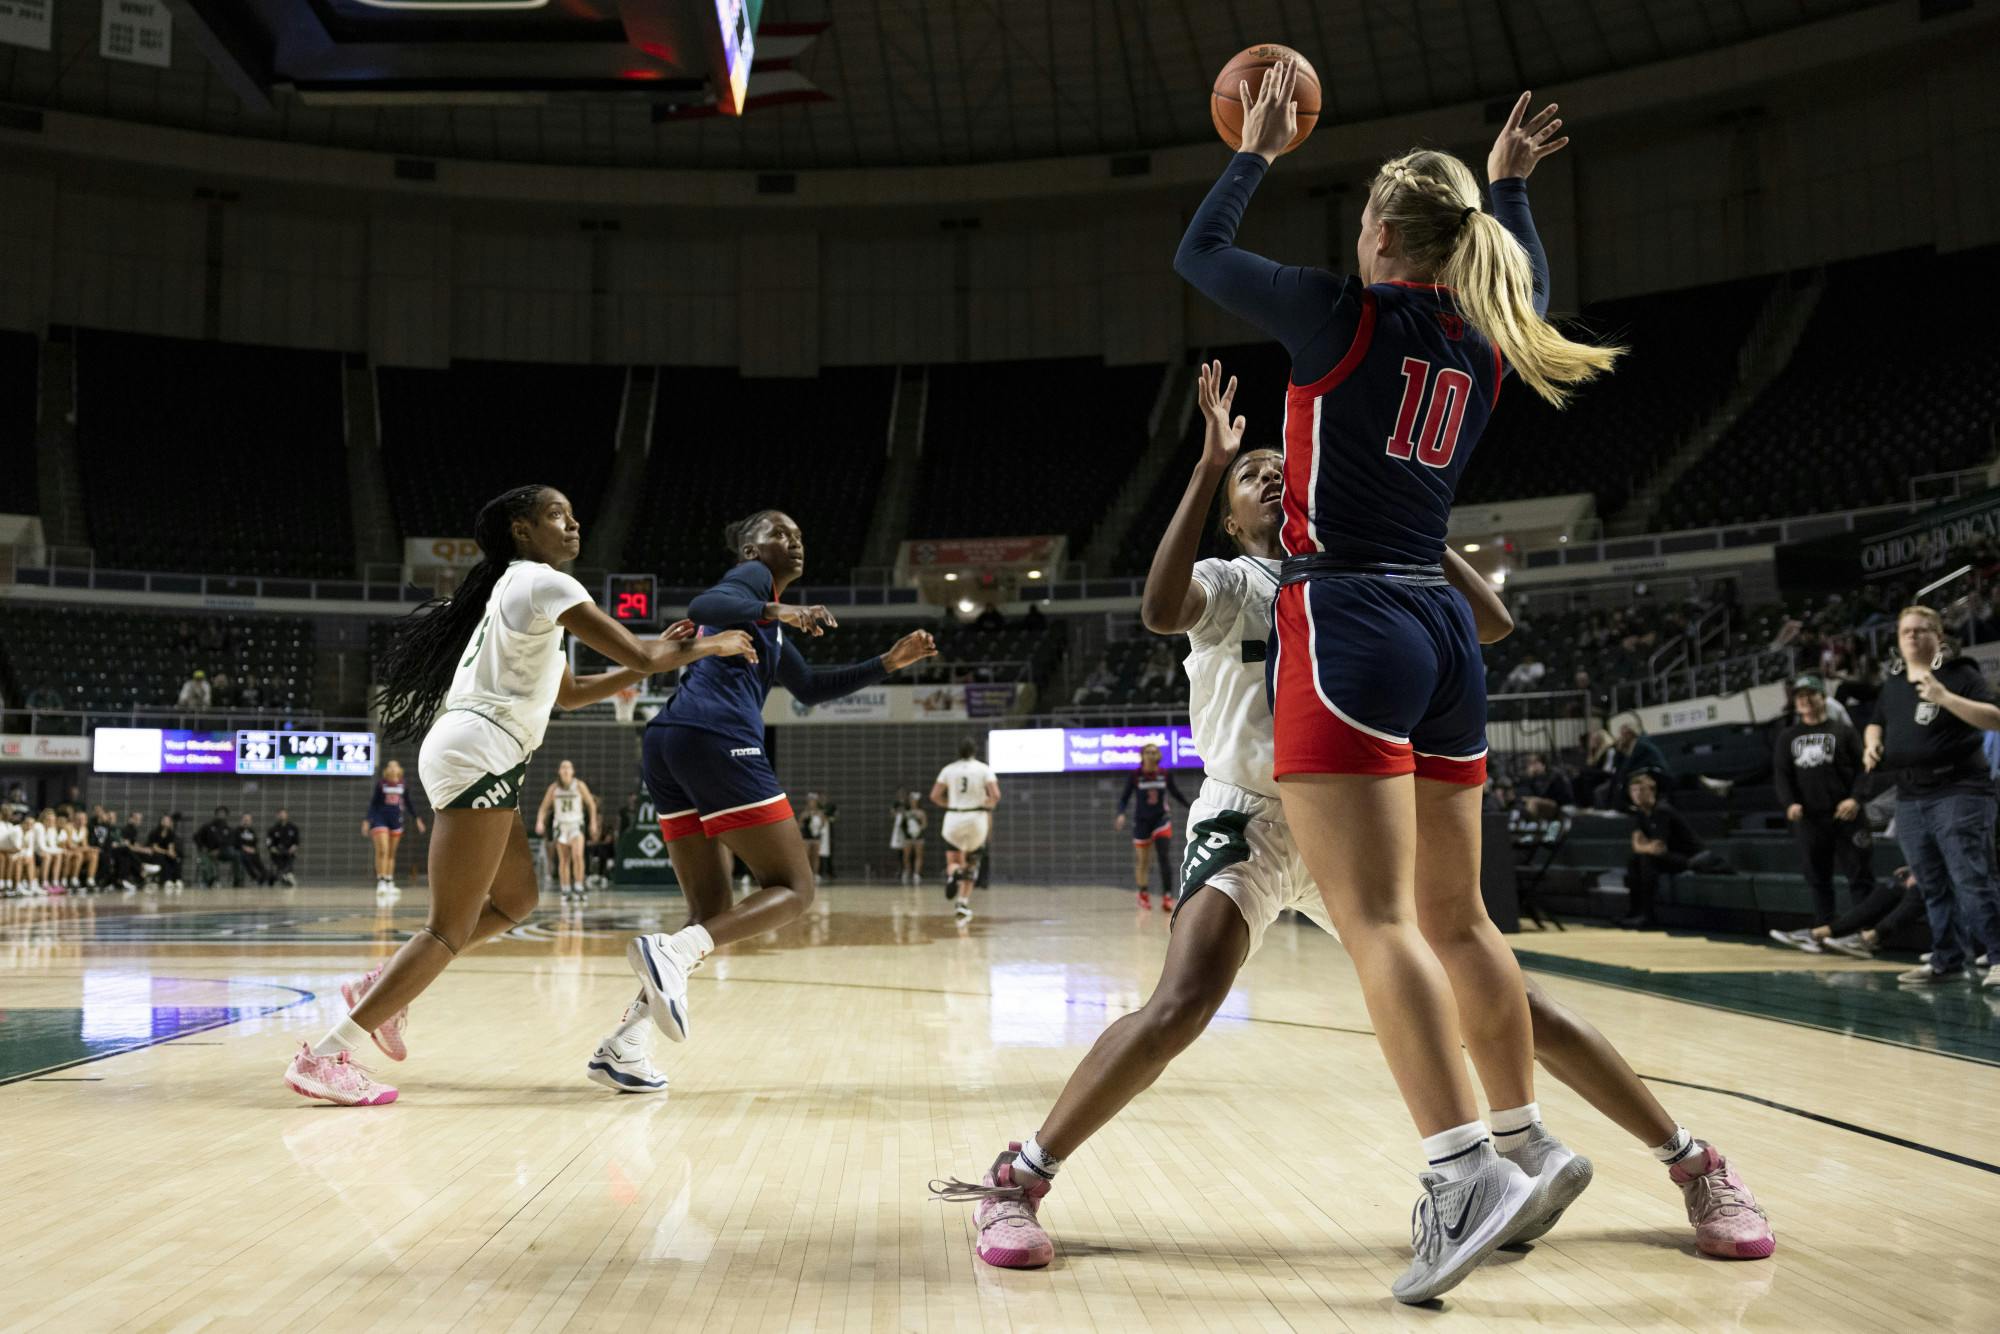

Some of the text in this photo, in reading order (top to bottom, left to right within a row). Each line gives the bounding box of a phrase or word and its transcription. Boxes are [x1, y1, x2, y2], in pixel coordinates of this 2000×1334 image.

[1385, 356, 1473, 469] 10
[1861, 535, 1916, 572] OHIO
[617, 592, 648, 619] 29
[246, 742, 270, 761] 29
[289, 735, 328, 754] 1:49
[344, 744, 367, 762] 24
